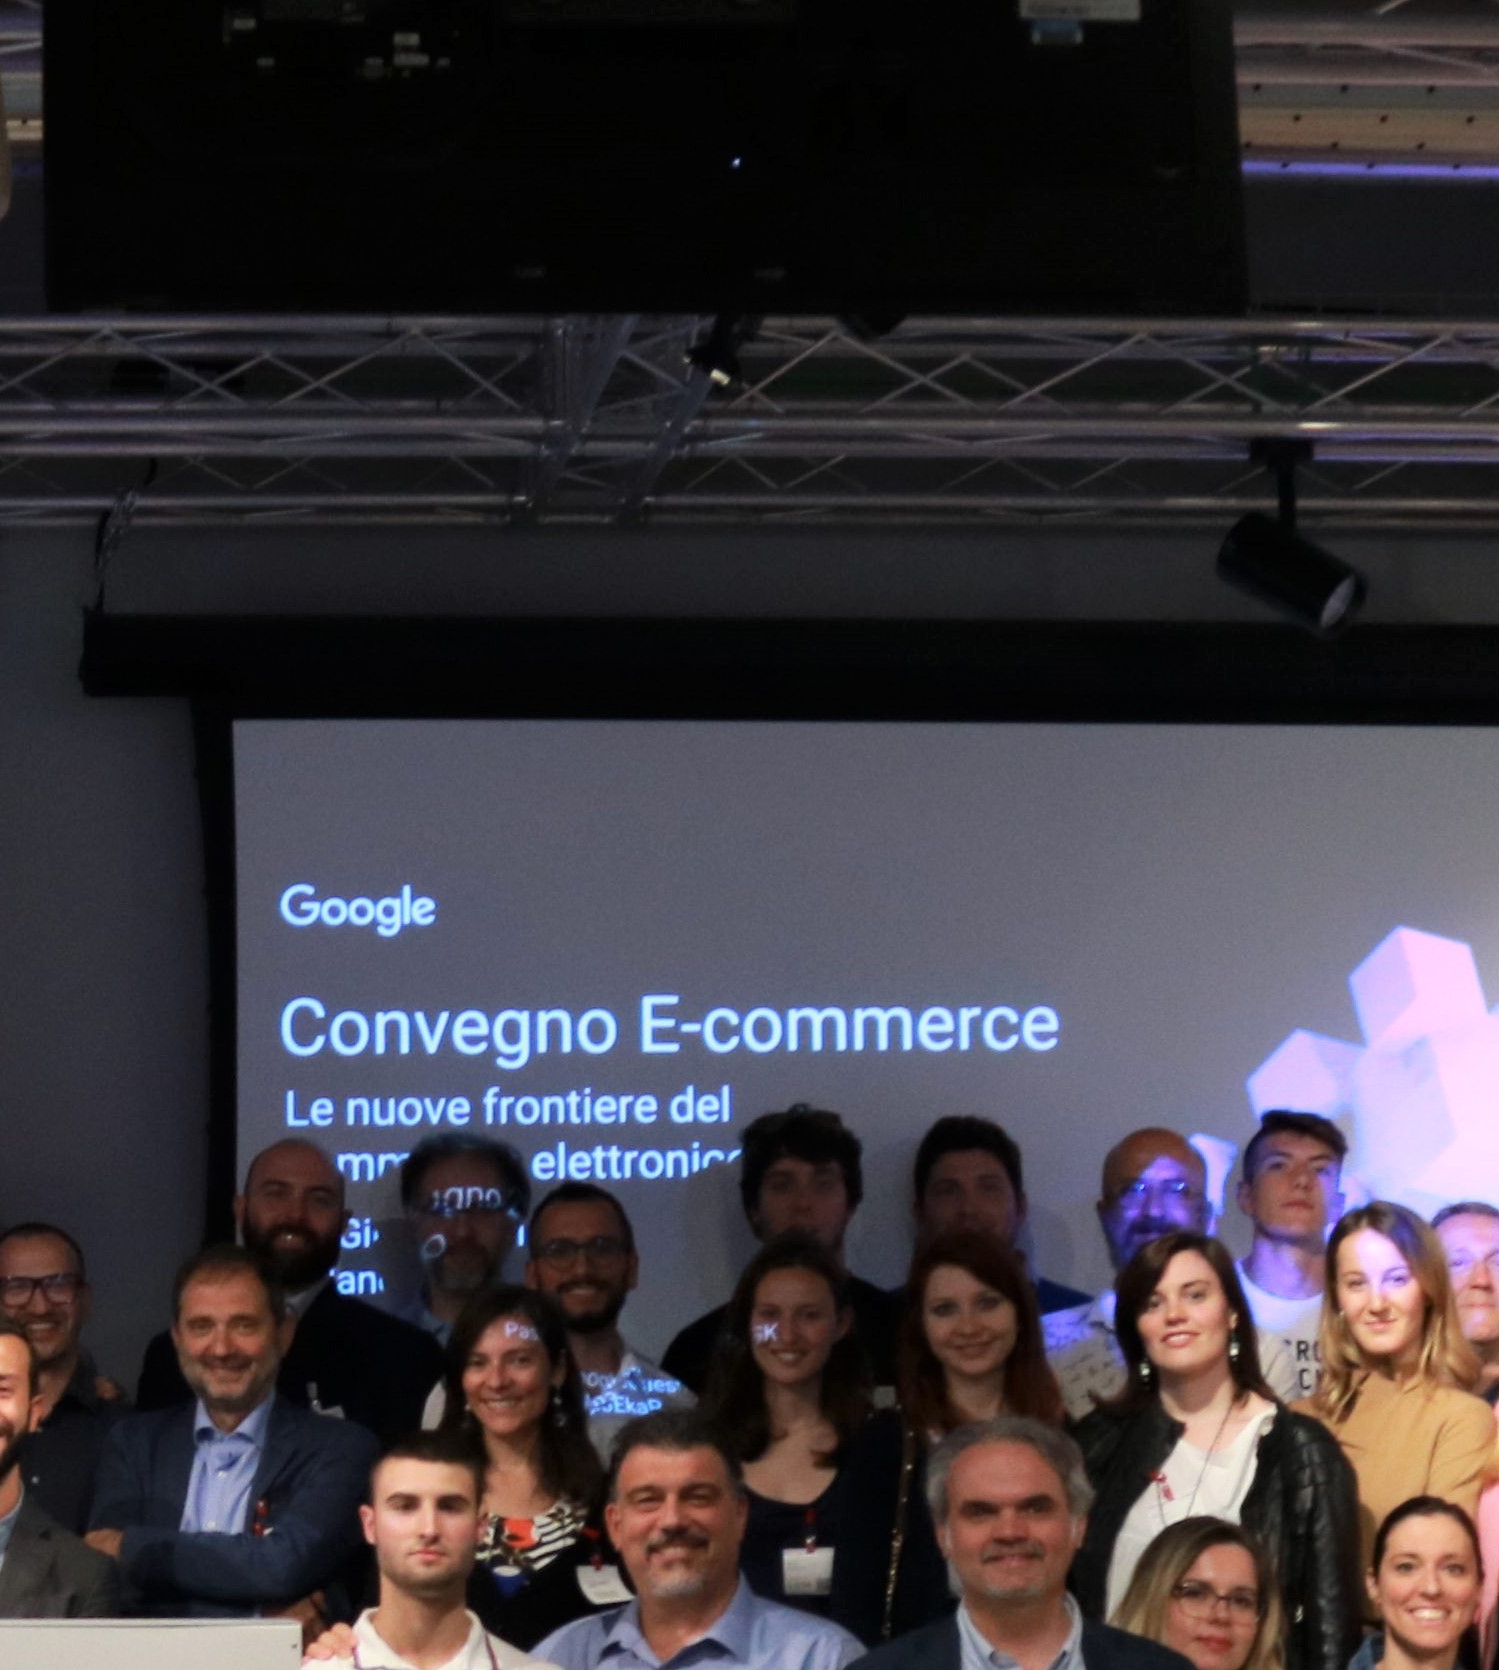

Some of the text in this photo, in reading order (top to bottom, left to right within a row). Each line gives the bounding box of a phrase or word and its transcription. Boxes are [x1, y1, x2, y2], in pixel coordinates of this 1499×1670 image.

[278, 883, 437, 938] Google
[279, 993, 1062, 1069] Convegno E-commerce
[285, 1084, 733, 1128] Le nuove frontiere del
[530, 1141, 742, 1180] elettronic
